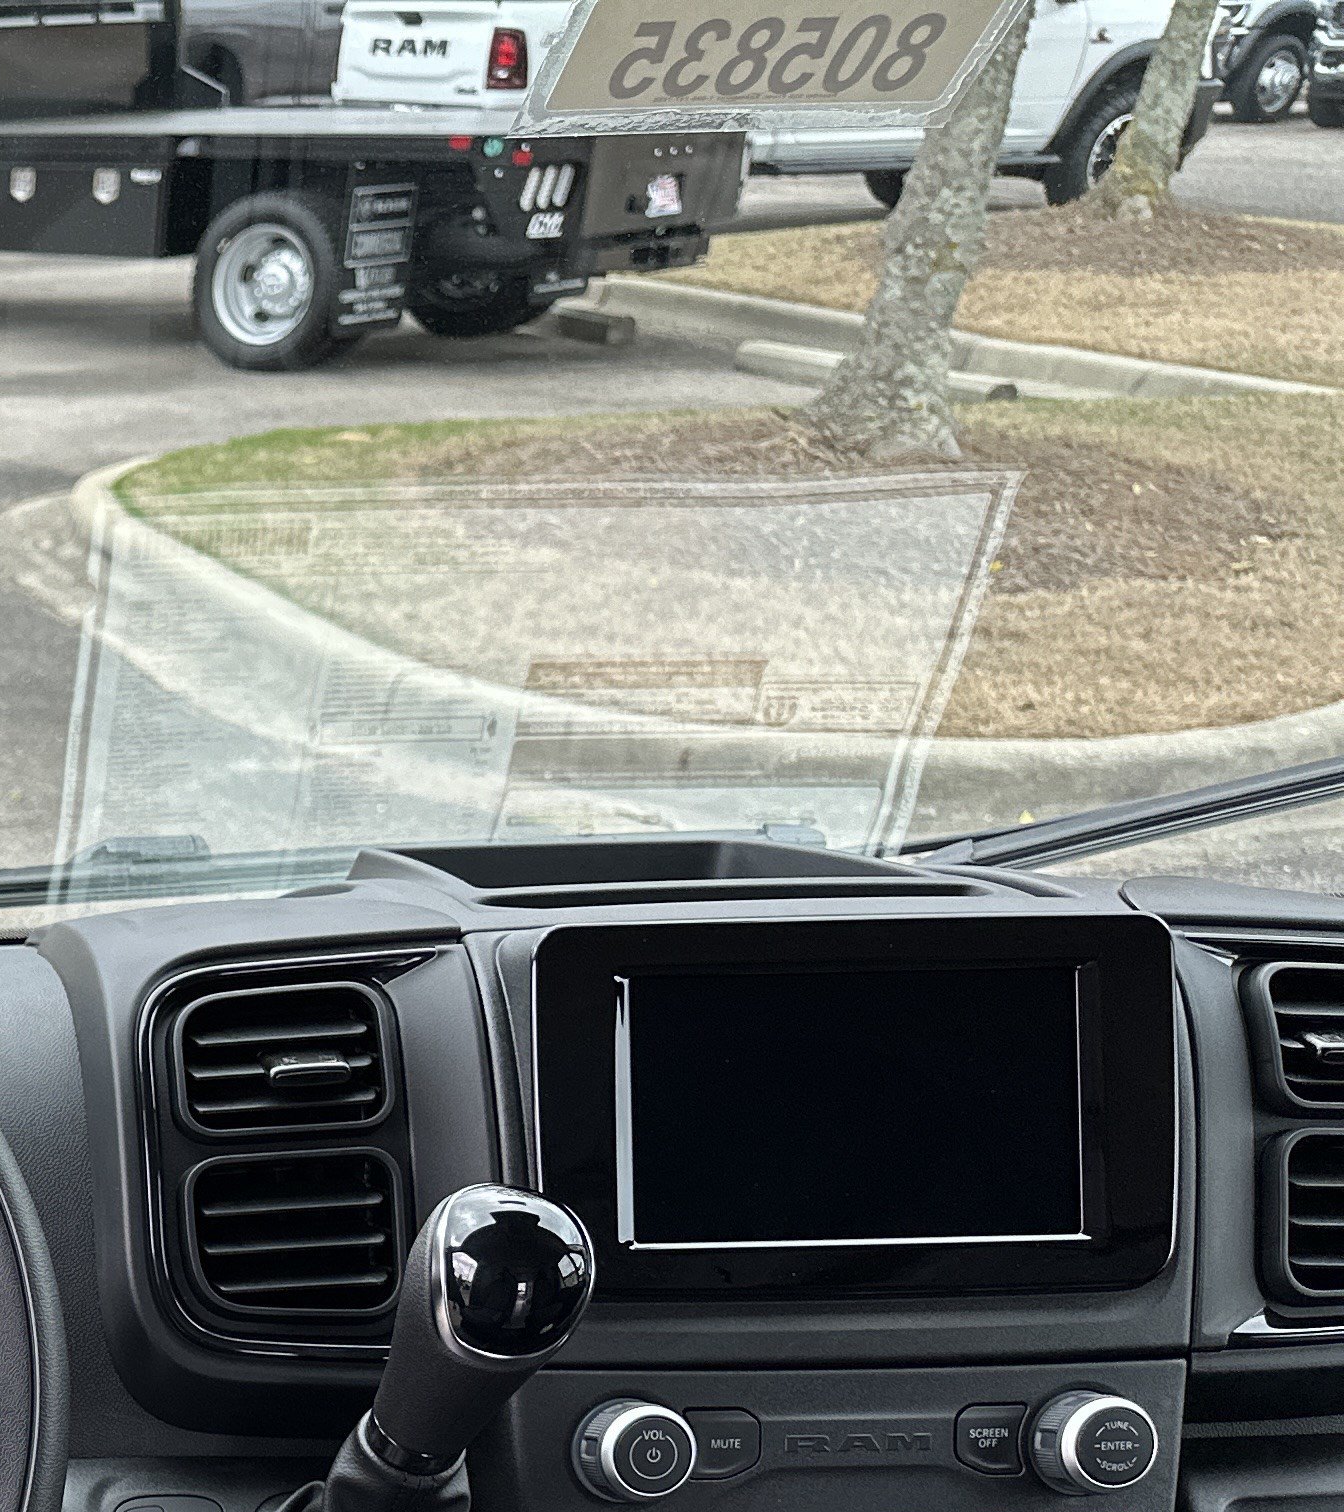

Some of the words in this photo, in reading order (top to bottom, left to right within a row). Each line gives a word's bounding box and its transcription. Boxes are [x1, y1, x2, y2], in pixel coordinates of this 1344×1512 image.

[370, 37, 450, 58] RAM
[1104, 1421, 1130, 1430] TUNE
[642, 1429, 666, 1440] VOL
[969, 1428, 1009, 1438] SCREEN
[710, 1438, 741, 1449] MUTE
[783, 1433, 933, 1452] RAM
[978, 1439, 998, 1448] OFF
[1100, 1441, 1133, 1451] ENTER
[1100, 1459, 1134, 1471] SCROLL
